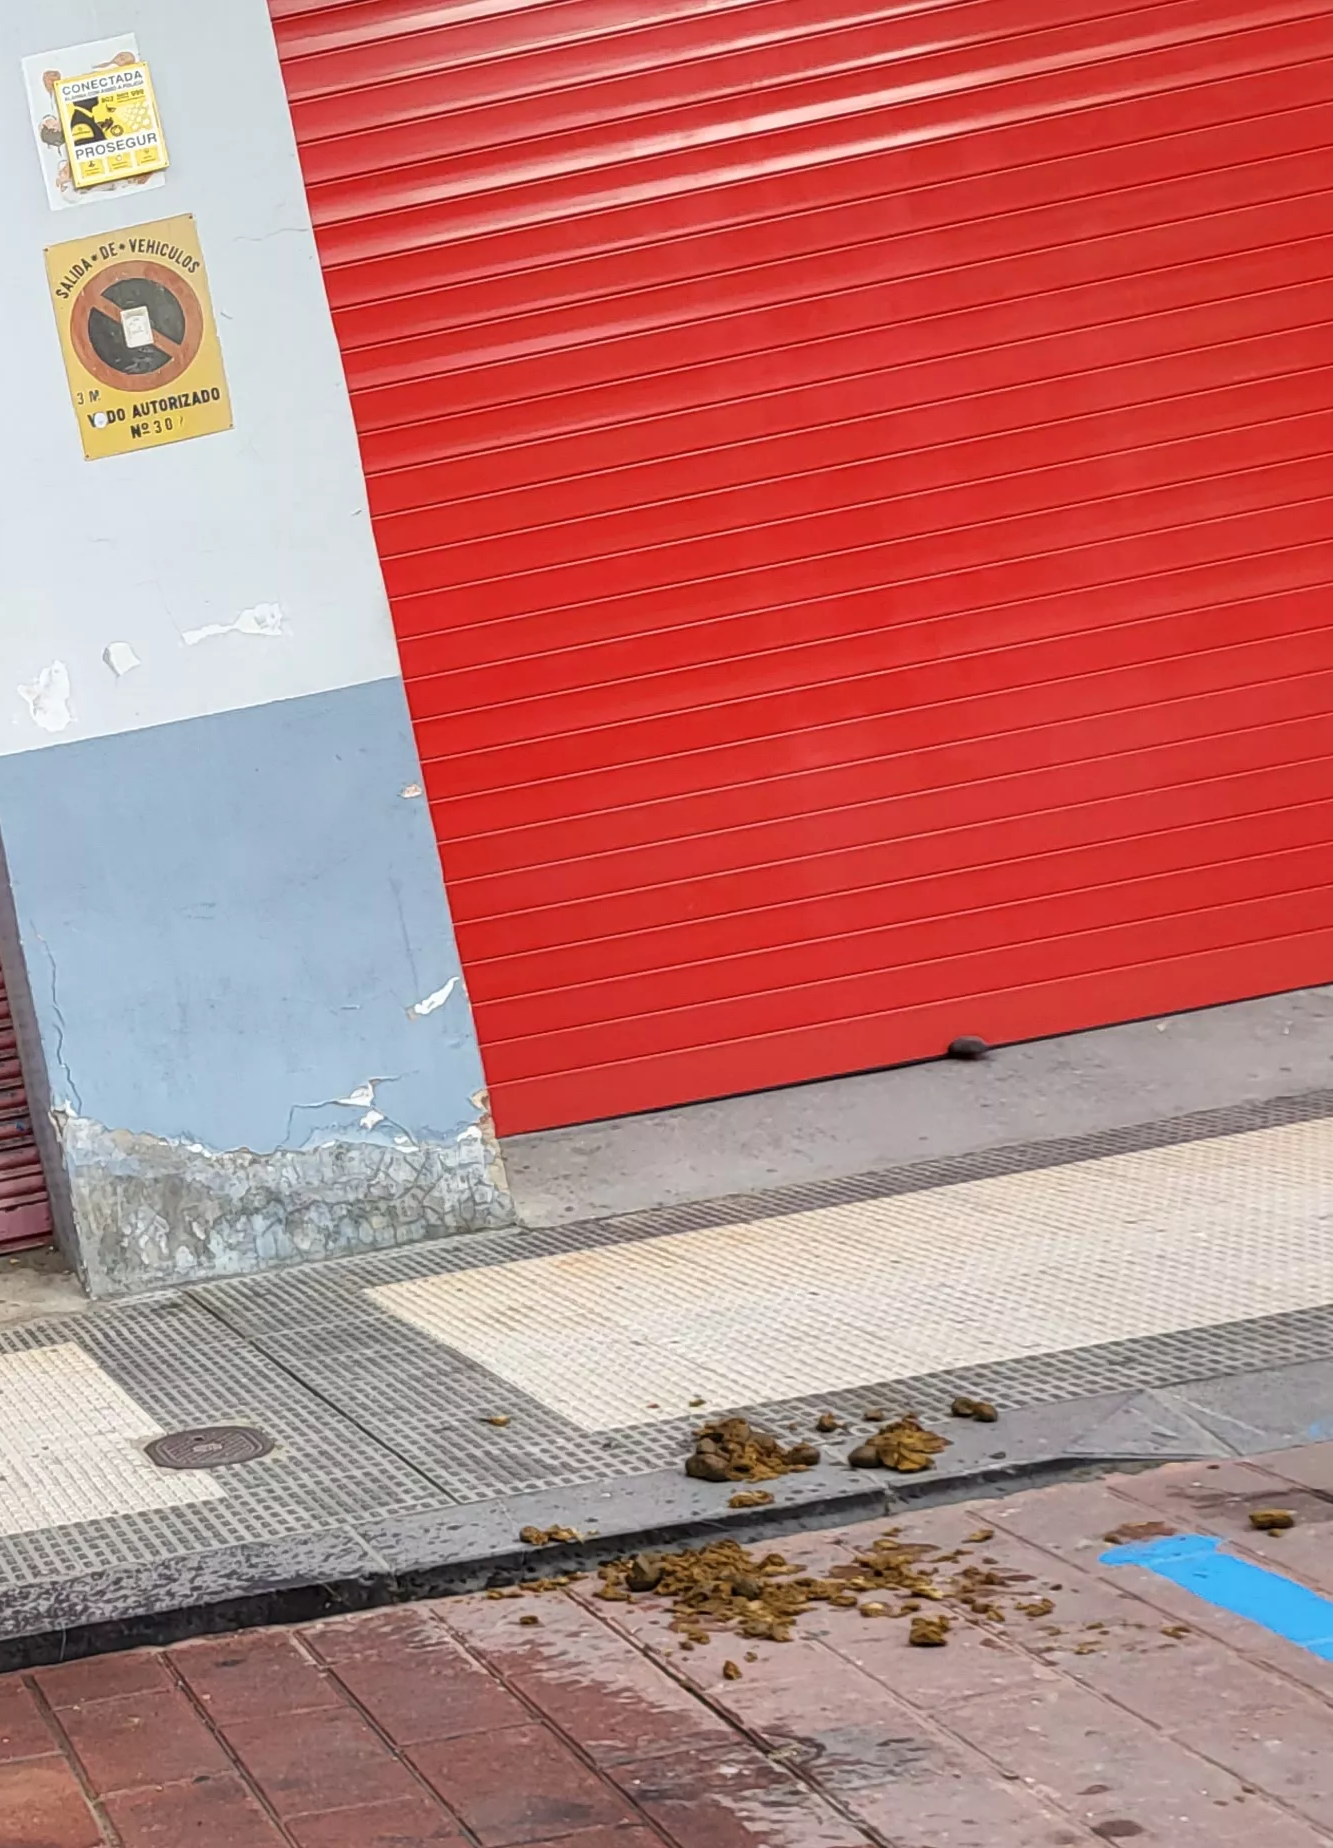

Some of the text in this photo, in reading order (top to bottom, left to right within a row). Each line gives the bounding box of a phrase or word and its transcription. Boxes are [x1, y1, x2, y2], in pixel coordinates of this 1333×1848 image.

[62, 70, 143, 96] CONECTADA
[75, 132, 158, 160] PROSEGUR
[55, 238, 201, 300] SALIDA DE VEHICULOS
[87, 387, 221, 429] VDO AUTORIZADO
